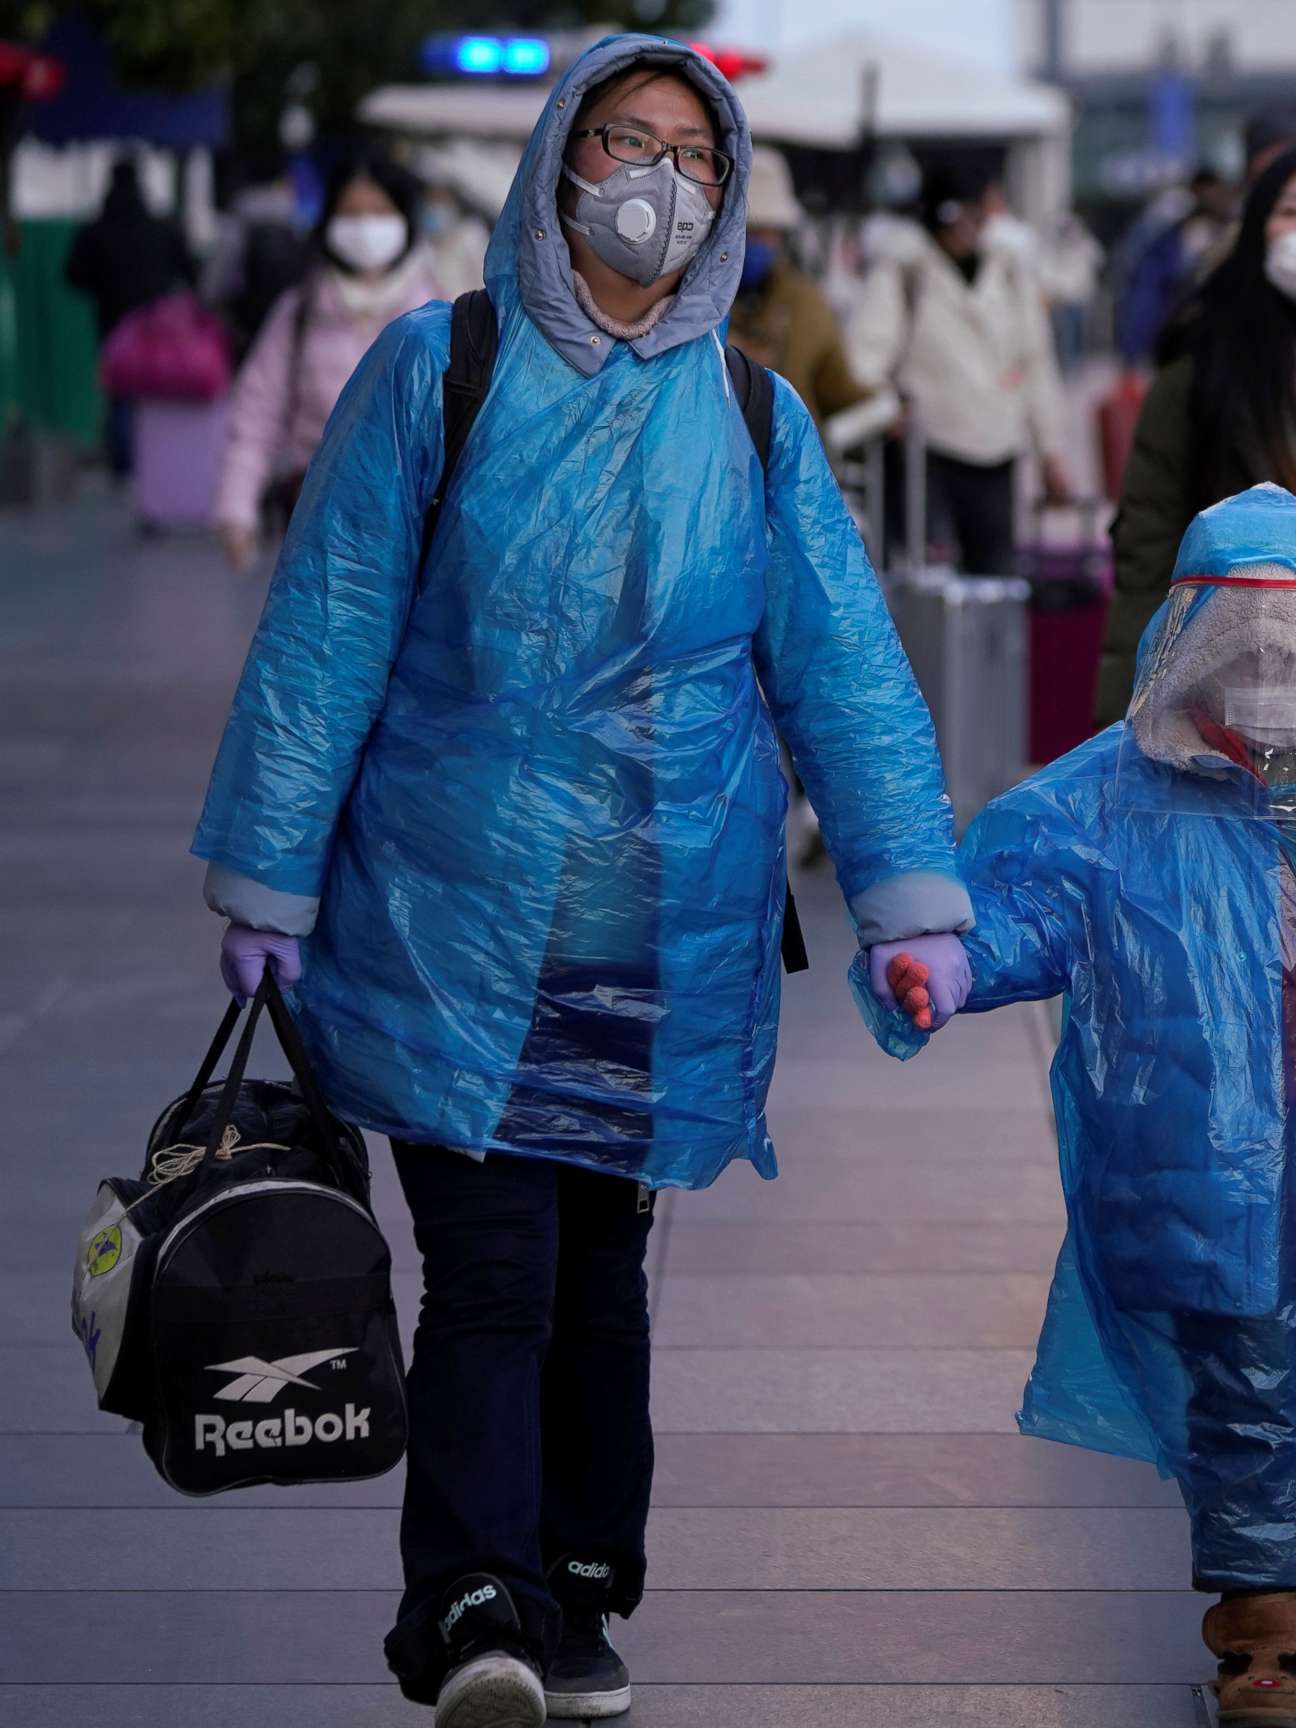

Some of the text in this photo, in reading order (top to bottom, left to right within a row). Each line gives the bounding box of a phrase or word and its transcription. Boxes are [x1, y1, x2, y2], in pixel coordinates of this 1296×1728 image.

[329, 1359, 347, 1370] TM
[195, 1403, 371, 1457] Reebok
[568, 1561, 611, 1579] adida
